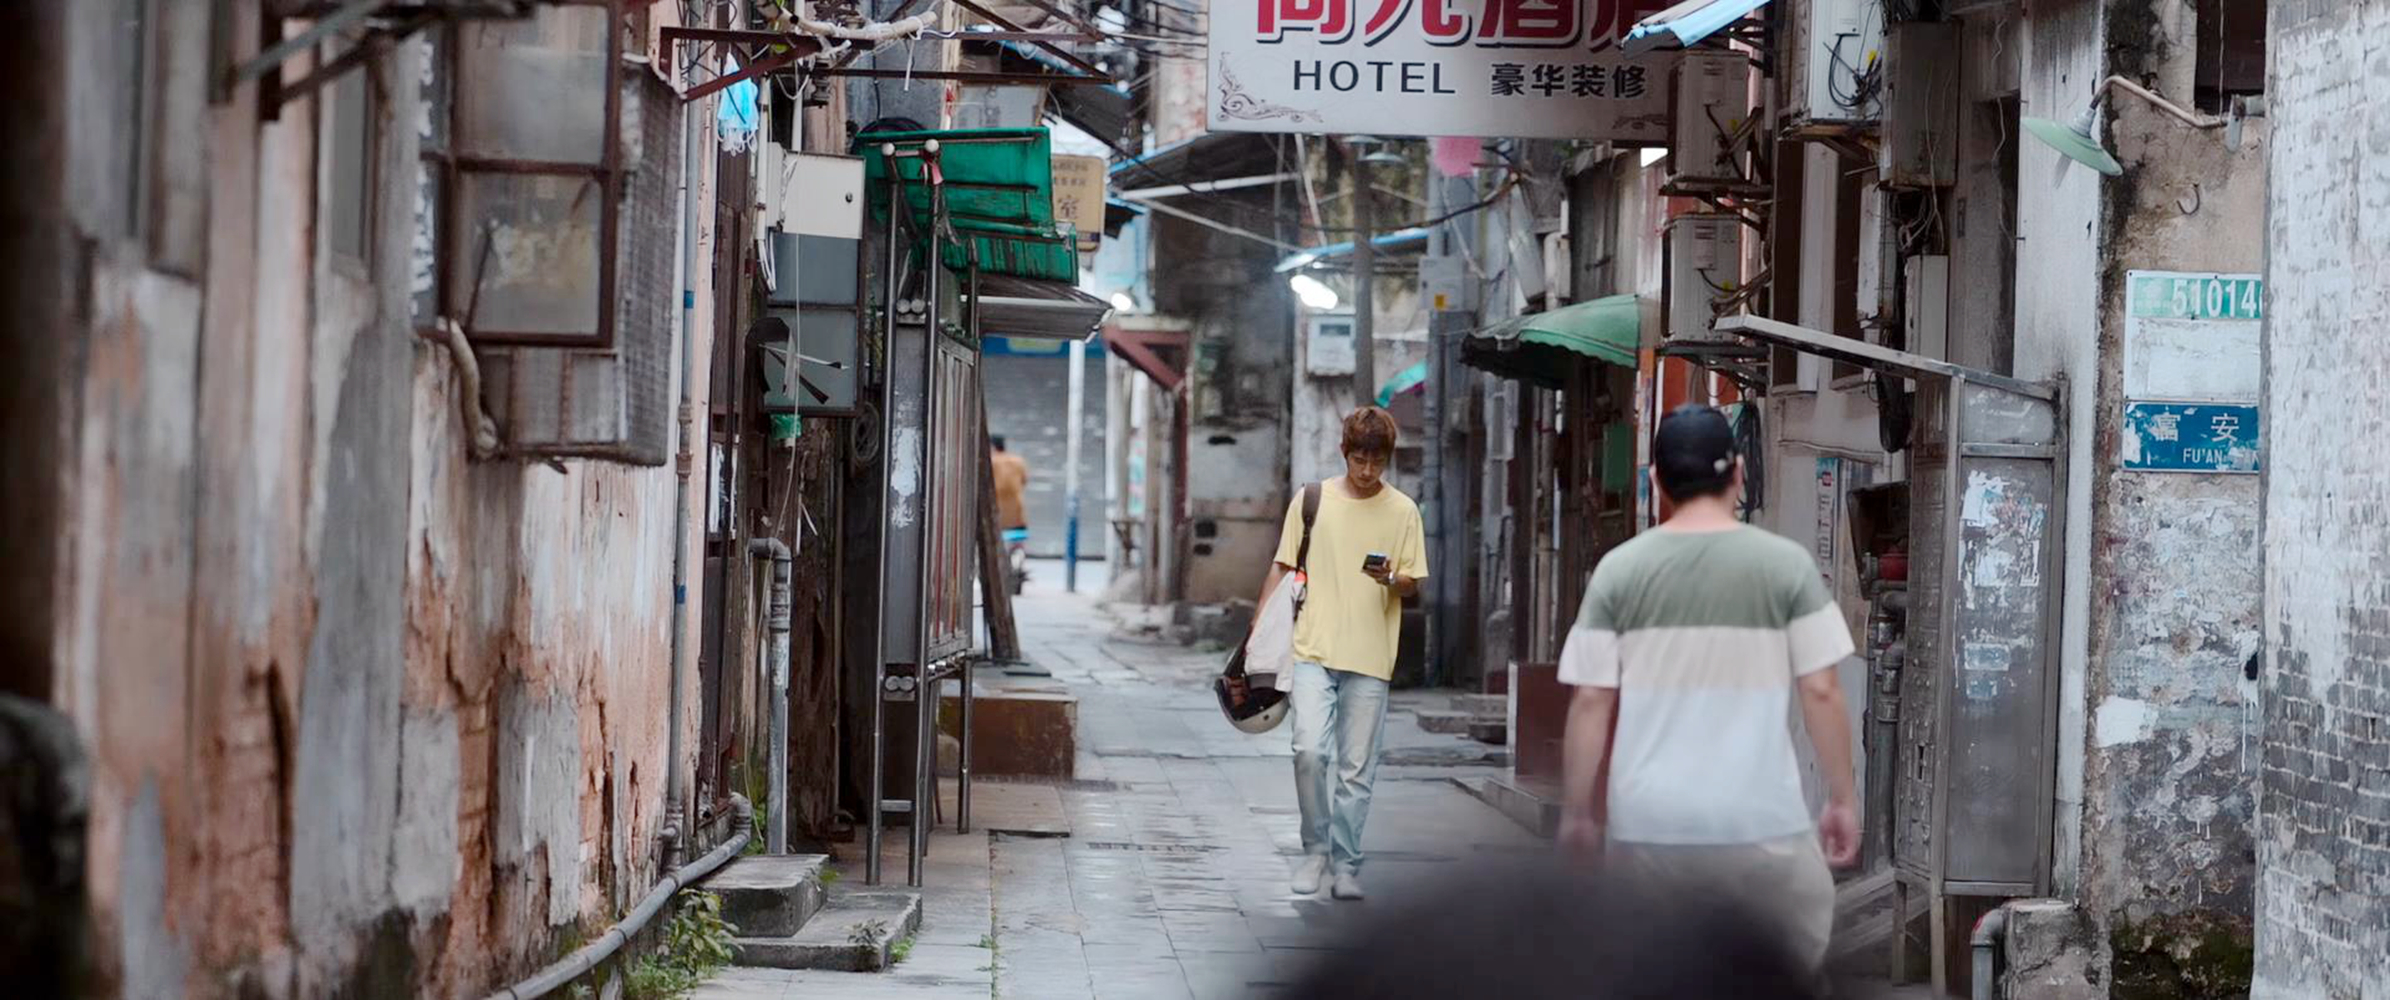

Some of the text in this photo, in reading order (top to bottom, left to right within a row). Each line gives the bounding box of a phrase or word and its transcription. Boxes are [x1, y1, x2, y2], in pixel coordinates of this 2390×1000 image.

[1293, 60, 1455, 94] HOTEL
[1490, 62, 1647, 99] 豪华装修
[2171, 279, 2262, 318] 51014
